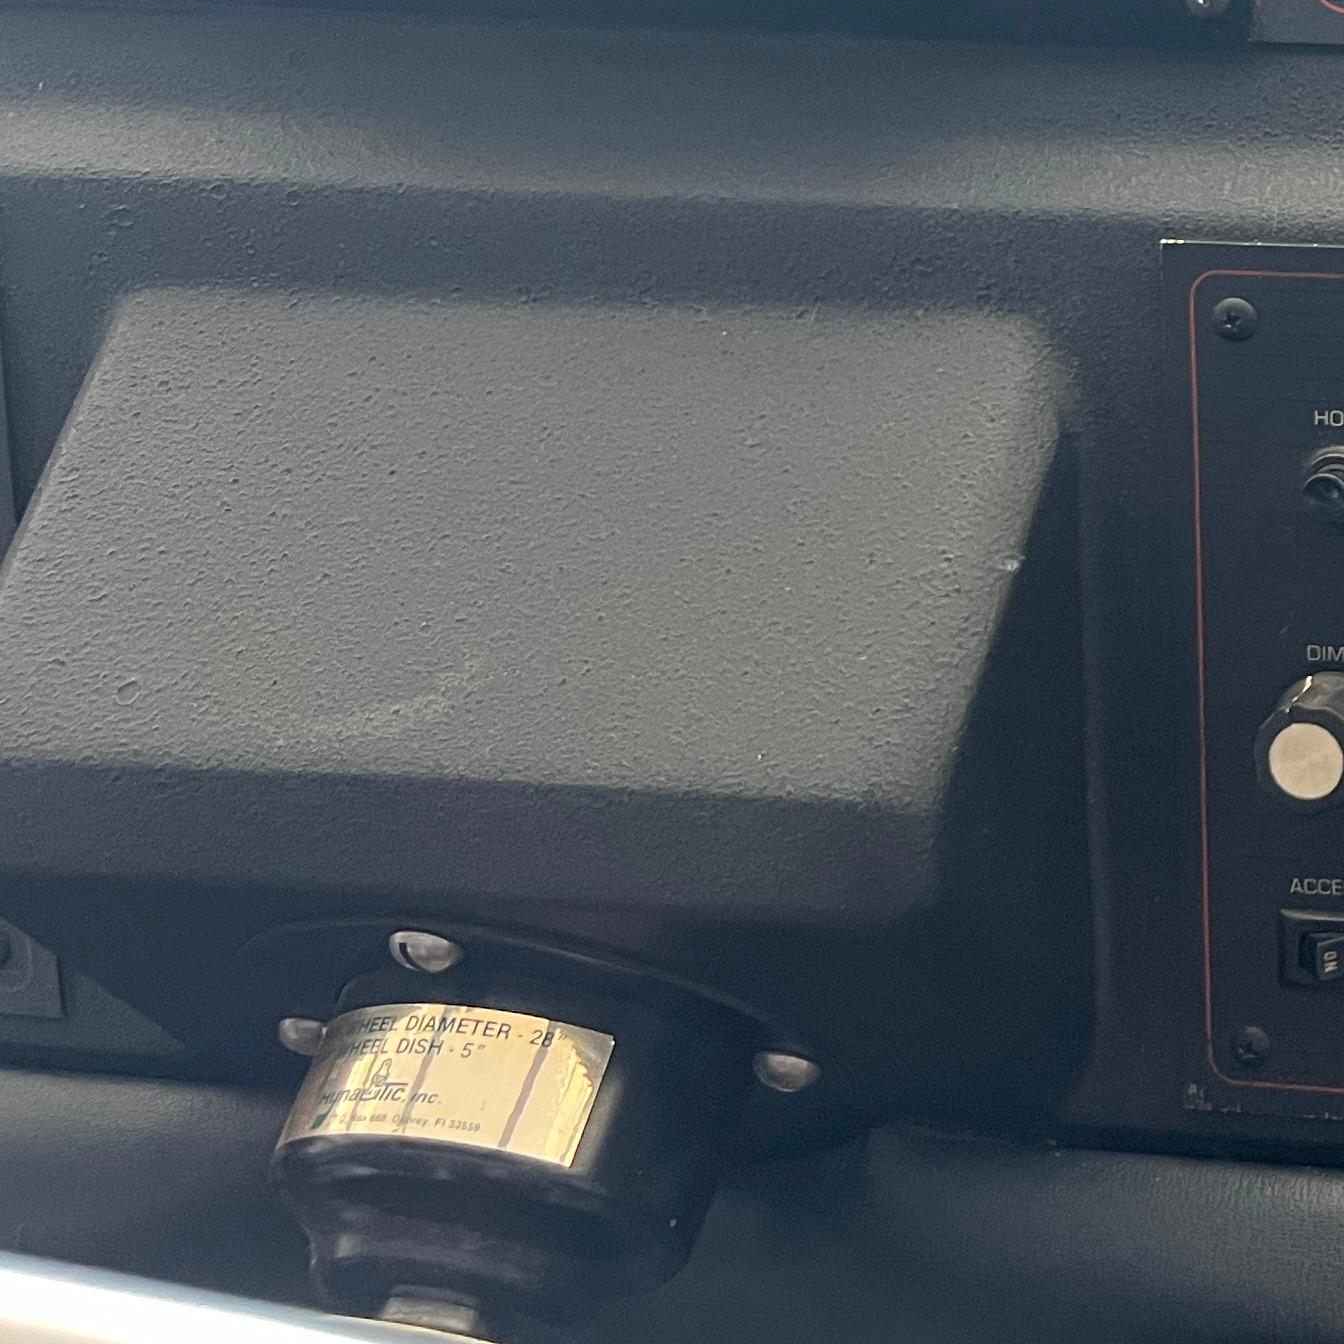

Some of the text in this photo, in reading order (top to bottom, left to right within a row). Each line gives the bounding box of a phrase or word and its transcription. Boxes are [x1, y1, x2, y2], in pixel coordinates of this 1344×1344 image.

[1323, 950, 1339, 974] ON
[404, 1014, 513, 1041] DIAMETER
[395, 1038, 444, 1055] DISH
